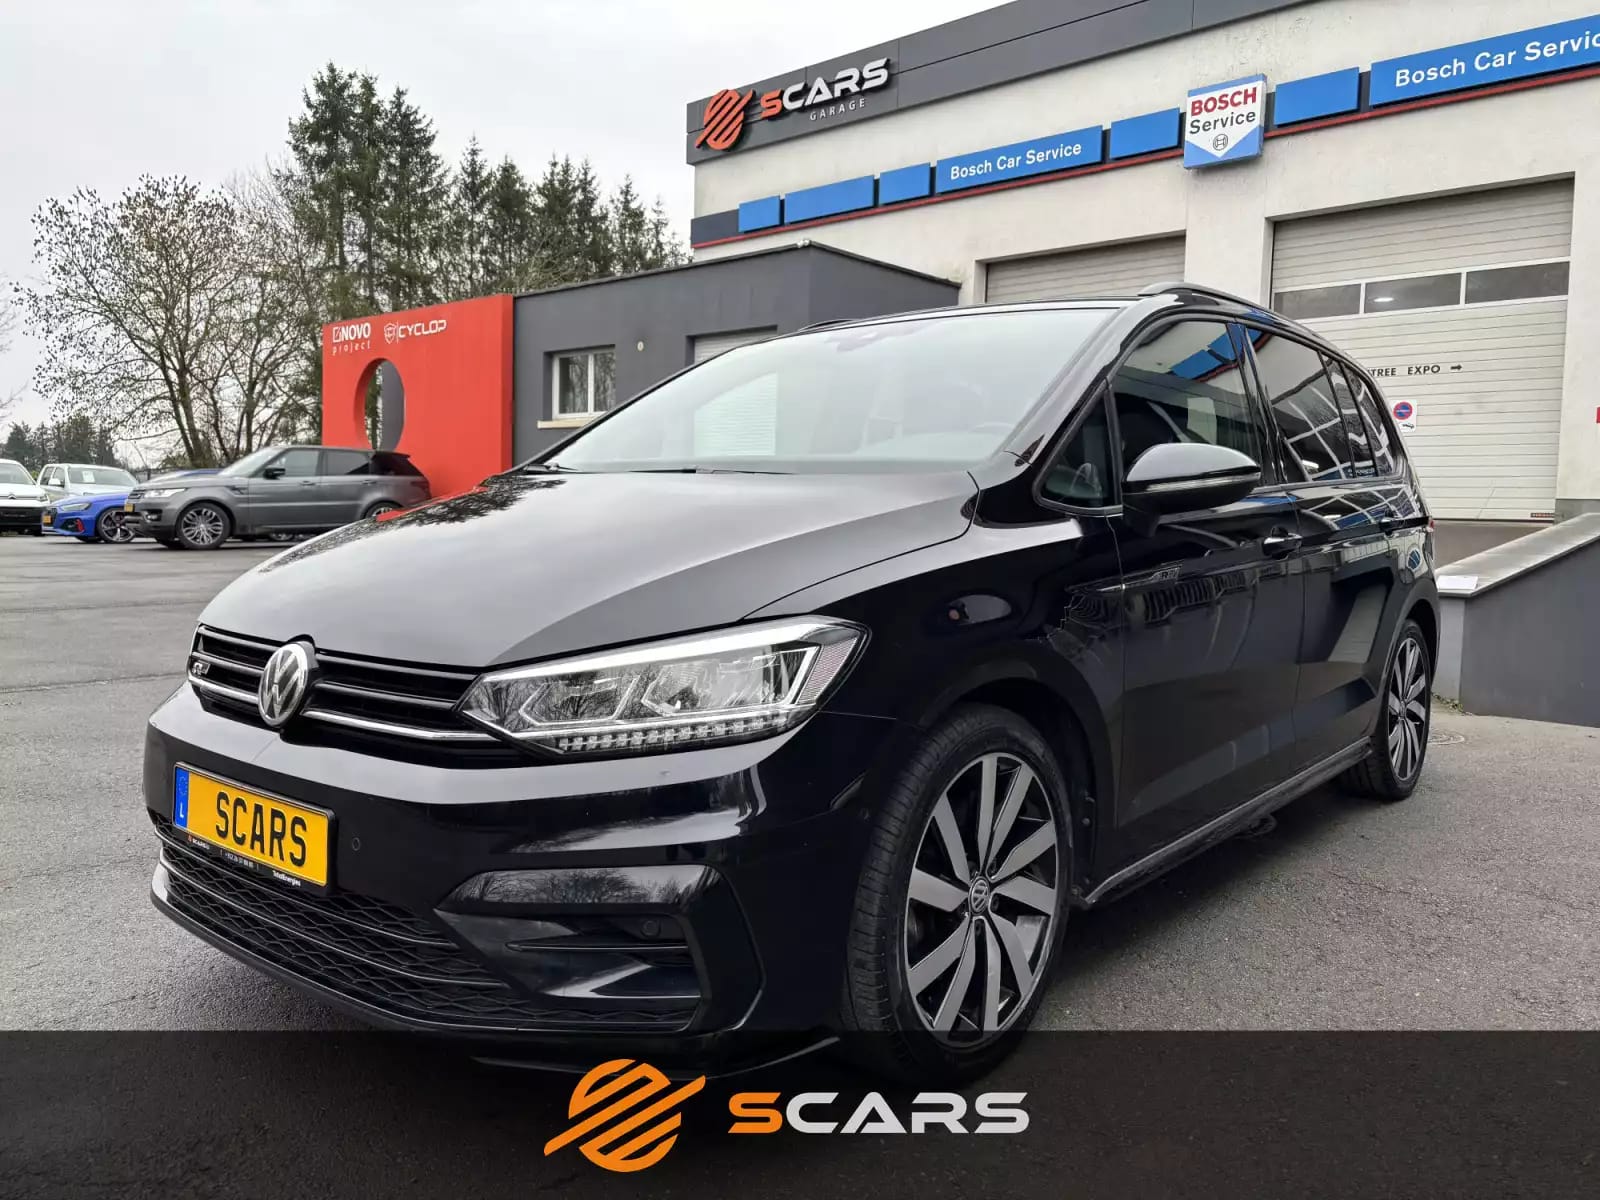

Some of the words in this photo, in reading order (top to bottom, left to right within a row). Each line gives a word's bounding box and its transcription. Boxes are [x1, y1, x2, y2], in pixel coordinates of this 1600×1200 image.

[1395, 59, 1466, 88] Bosch
[1474, 50, 1516, 71] Car
[1524, 30, 1600, 61] Servic
[760, 57, 889, 119] SCARS
[1190, 86, 1257, 117] BOSCH
[809, 98, 866, 121] GARAGE
[1189, 111, 1256, 135] Service
[950, 159, 992, 180] Bosch
[996, 154, 1022, 170] Car
[1025, 143, 1082, 165] Service
[398, 319, 447, 339] CYCLOP
[332, 339, 370, 357] project
[1407, 364, 1441, 376] EXPO
[215, 791, 308, 868] SCARS
